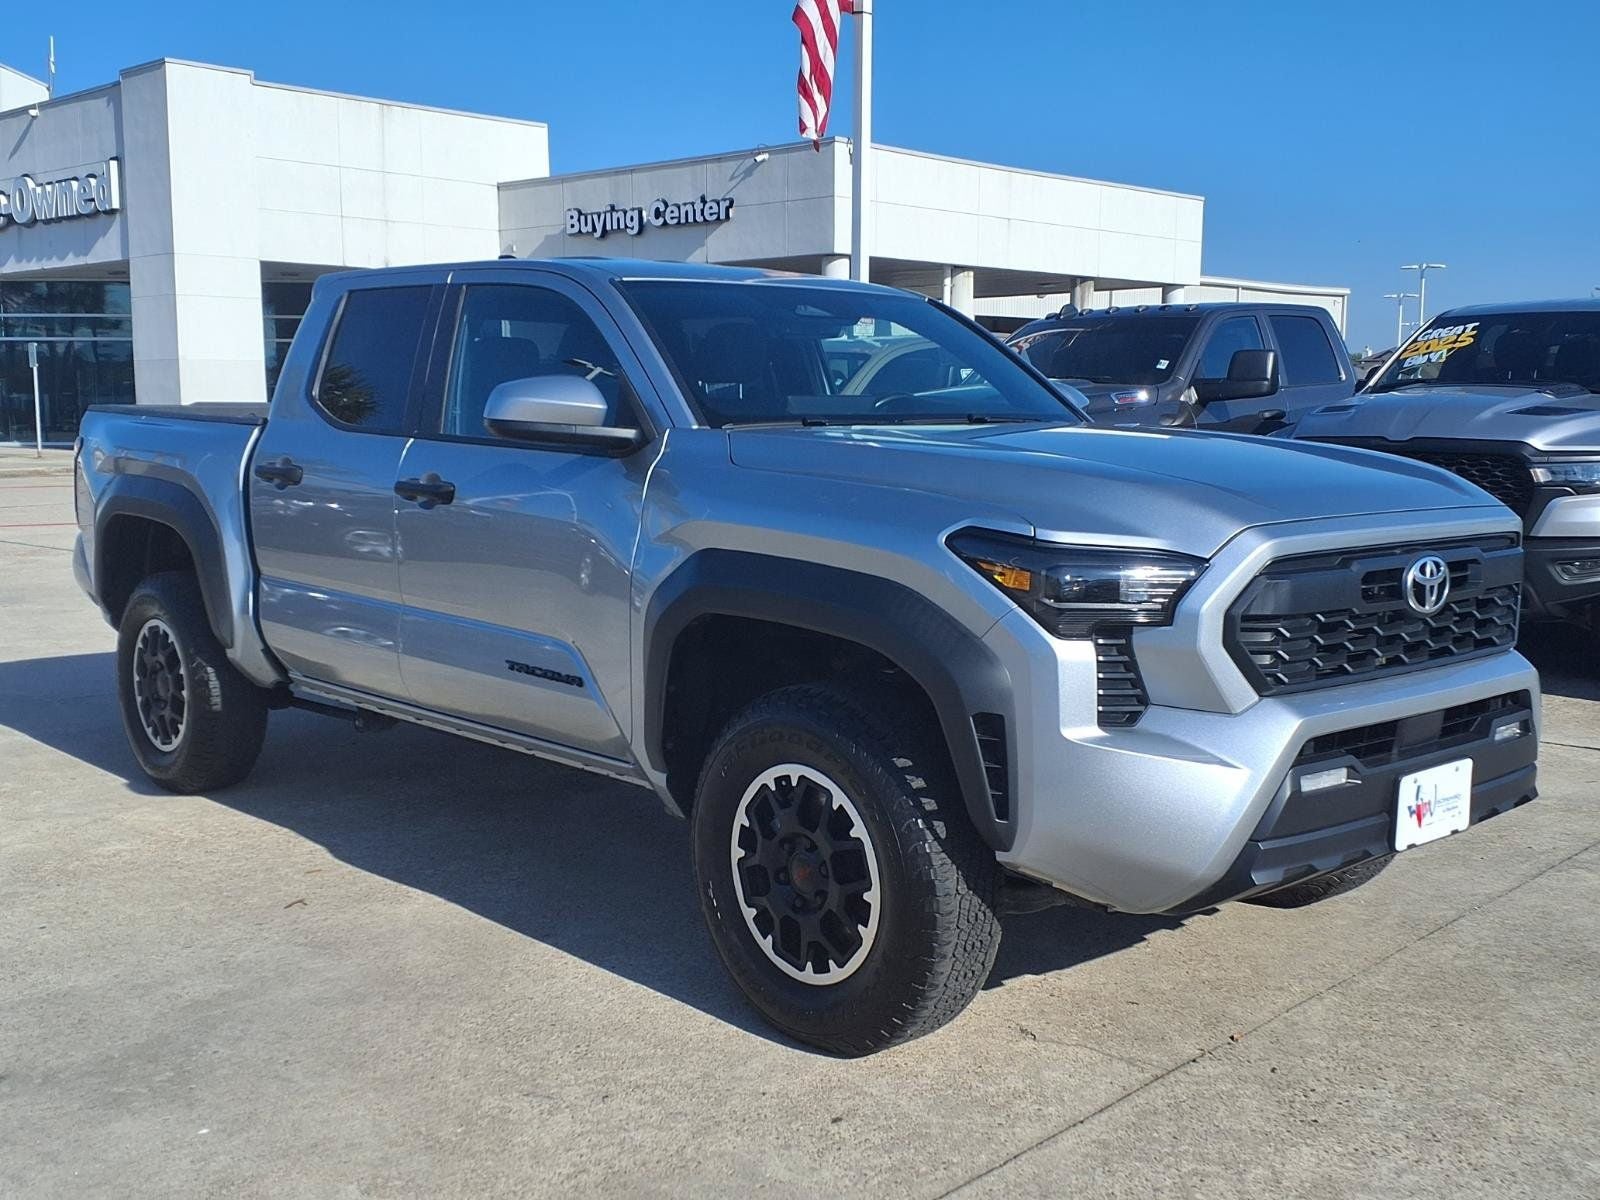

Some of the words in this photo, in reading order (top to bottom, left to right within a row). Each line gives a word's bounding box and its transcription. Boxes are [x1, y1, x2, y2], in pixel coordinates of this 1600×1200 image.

[0, 158, 120, 225] -Owned
[565, 205, 642, 238] Buying
[649, 197, 733, 227] Center
[1400, 330, 1477, 359] 2025
[1417, 322, 1480, 341] GREAT
[505, 659, 584, 687] TACOMA
